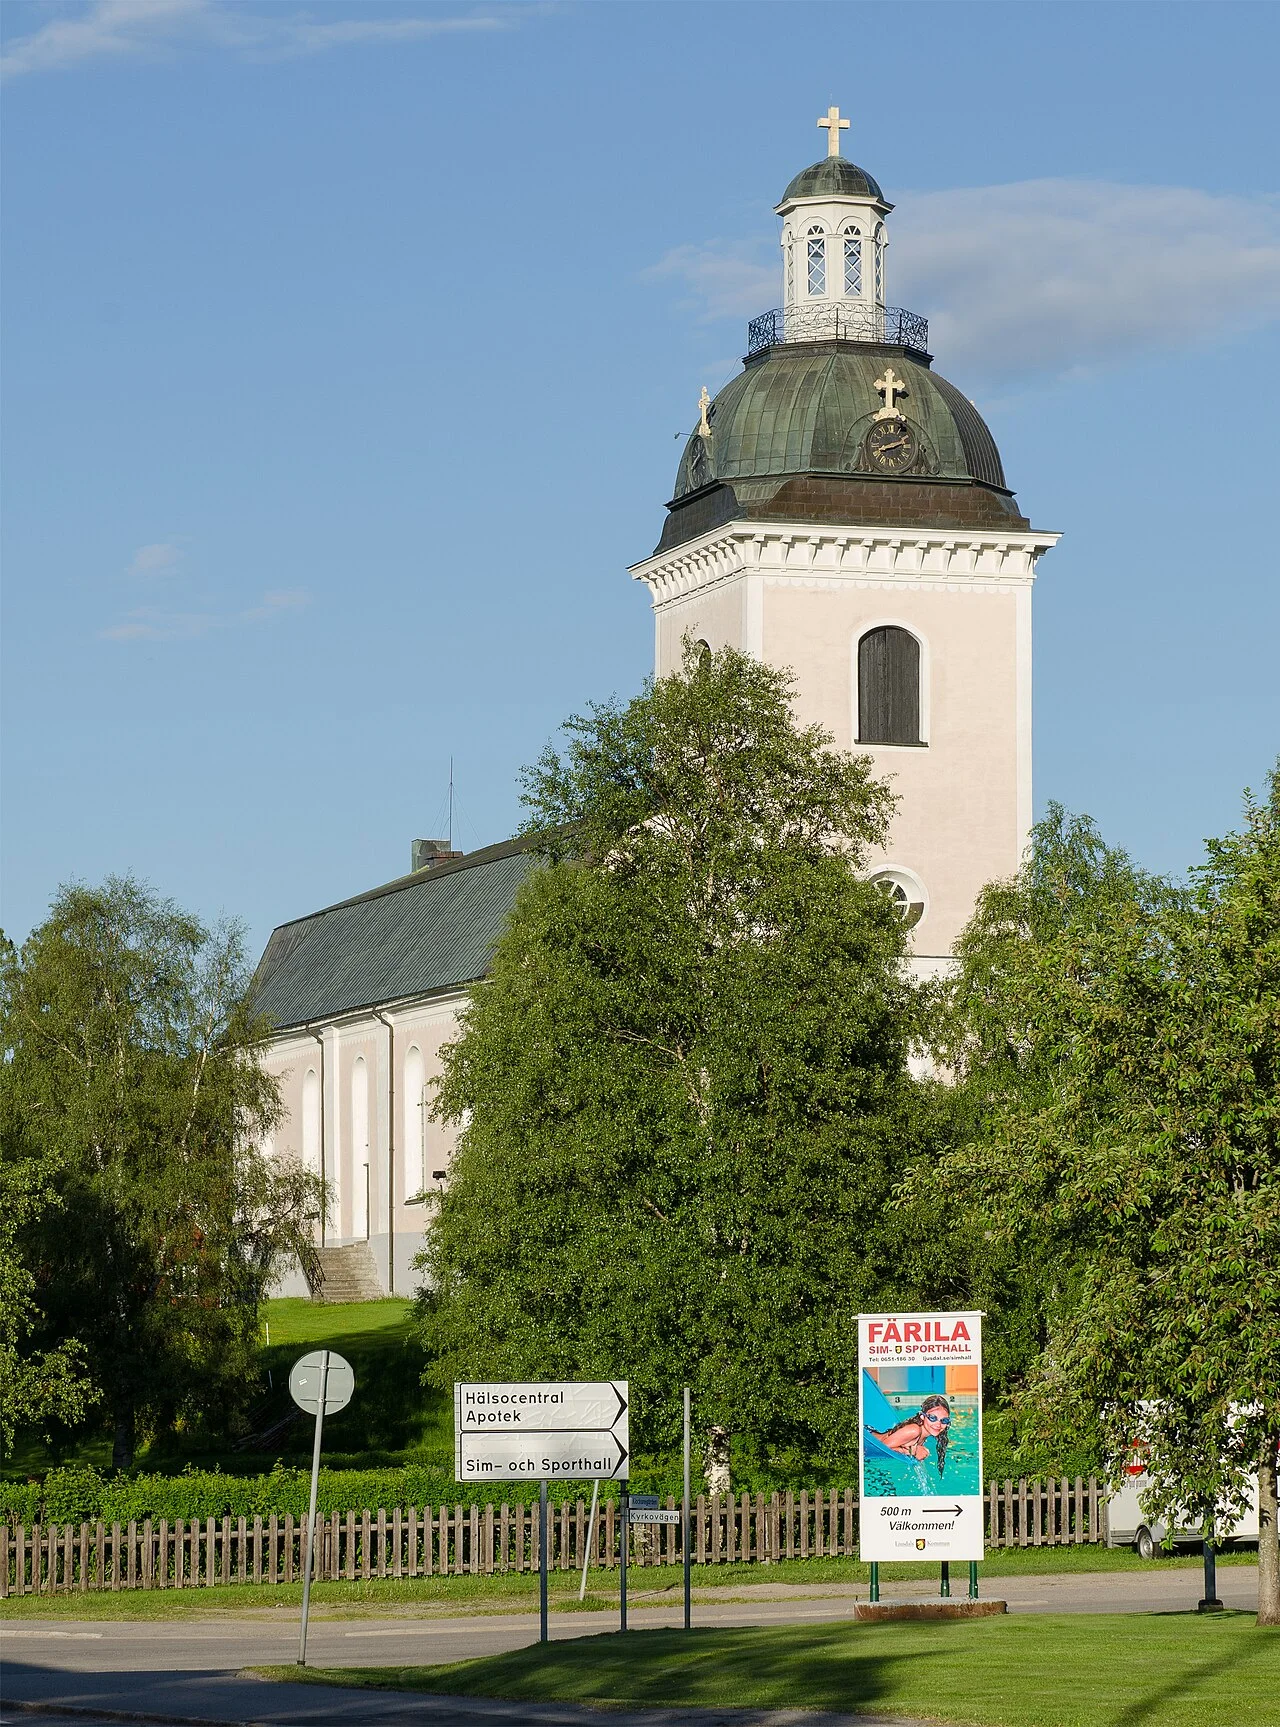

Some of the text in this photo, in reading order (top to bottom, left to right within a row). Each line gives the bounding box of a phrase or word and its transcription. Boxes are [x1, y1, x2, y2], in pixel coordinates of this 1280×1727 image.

[868, 1318, 971, 1343] FÄRILA
[869, 1344, 972, 1354] SIM- SPORTHALL
[465, 1391, 565, 1405] Hälsocentral
[466, 1409, 522, 1425] Apotek
[509, 1459, 535, 1472] och
[541, 1457, 612, 1474] Sporthall
[630, 1512, 679, 1522] Kyrkovägen
[880, 1506, 912, 1516] 500 m
[889, 1520, 955, 1531] Välkommen!
